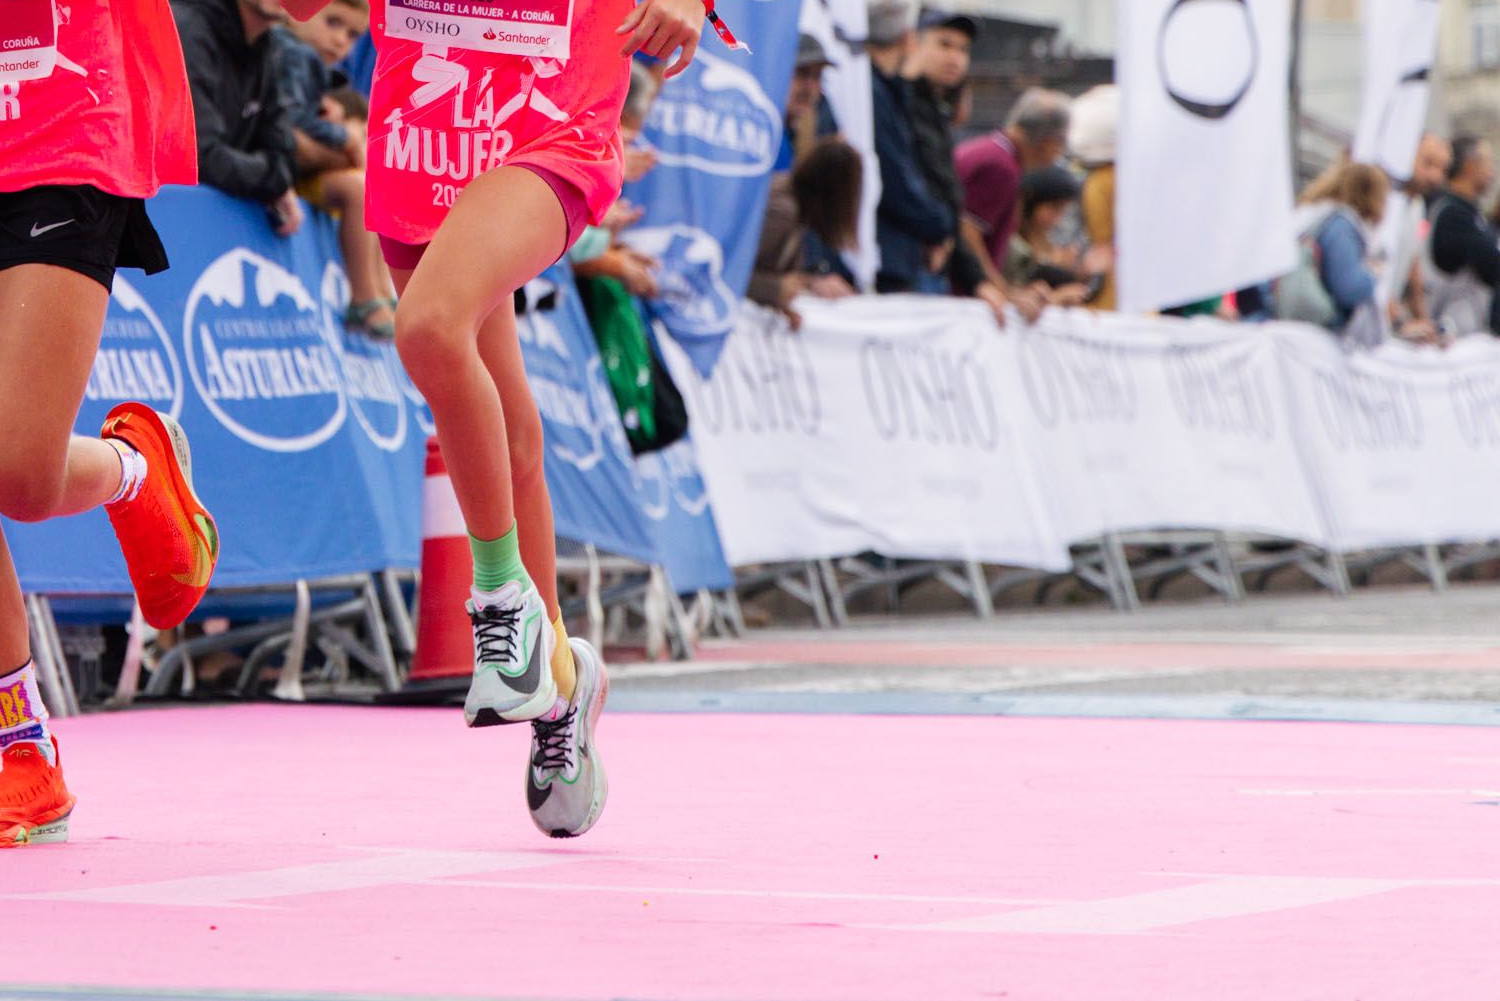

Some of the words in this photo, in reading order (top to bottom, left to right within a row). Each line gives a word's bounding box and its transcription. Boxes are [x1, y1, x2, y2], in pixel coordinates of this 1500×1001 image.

[443, 2, 455, 12] DE
[457, 3, 468, 14] LA
[471, 5, 504, 18] MUJER
[511, 10, 518, 19] A
[521, 9, 555, 23] CORUÑA
[2, 35, 40, 49] CORUÑA
[405, 16, 460, 37] OYSHO
[498, 31, 550, 46] Santander
[384, 122, 514, 181] MUJER
[432, 182, 463, 207] 20
